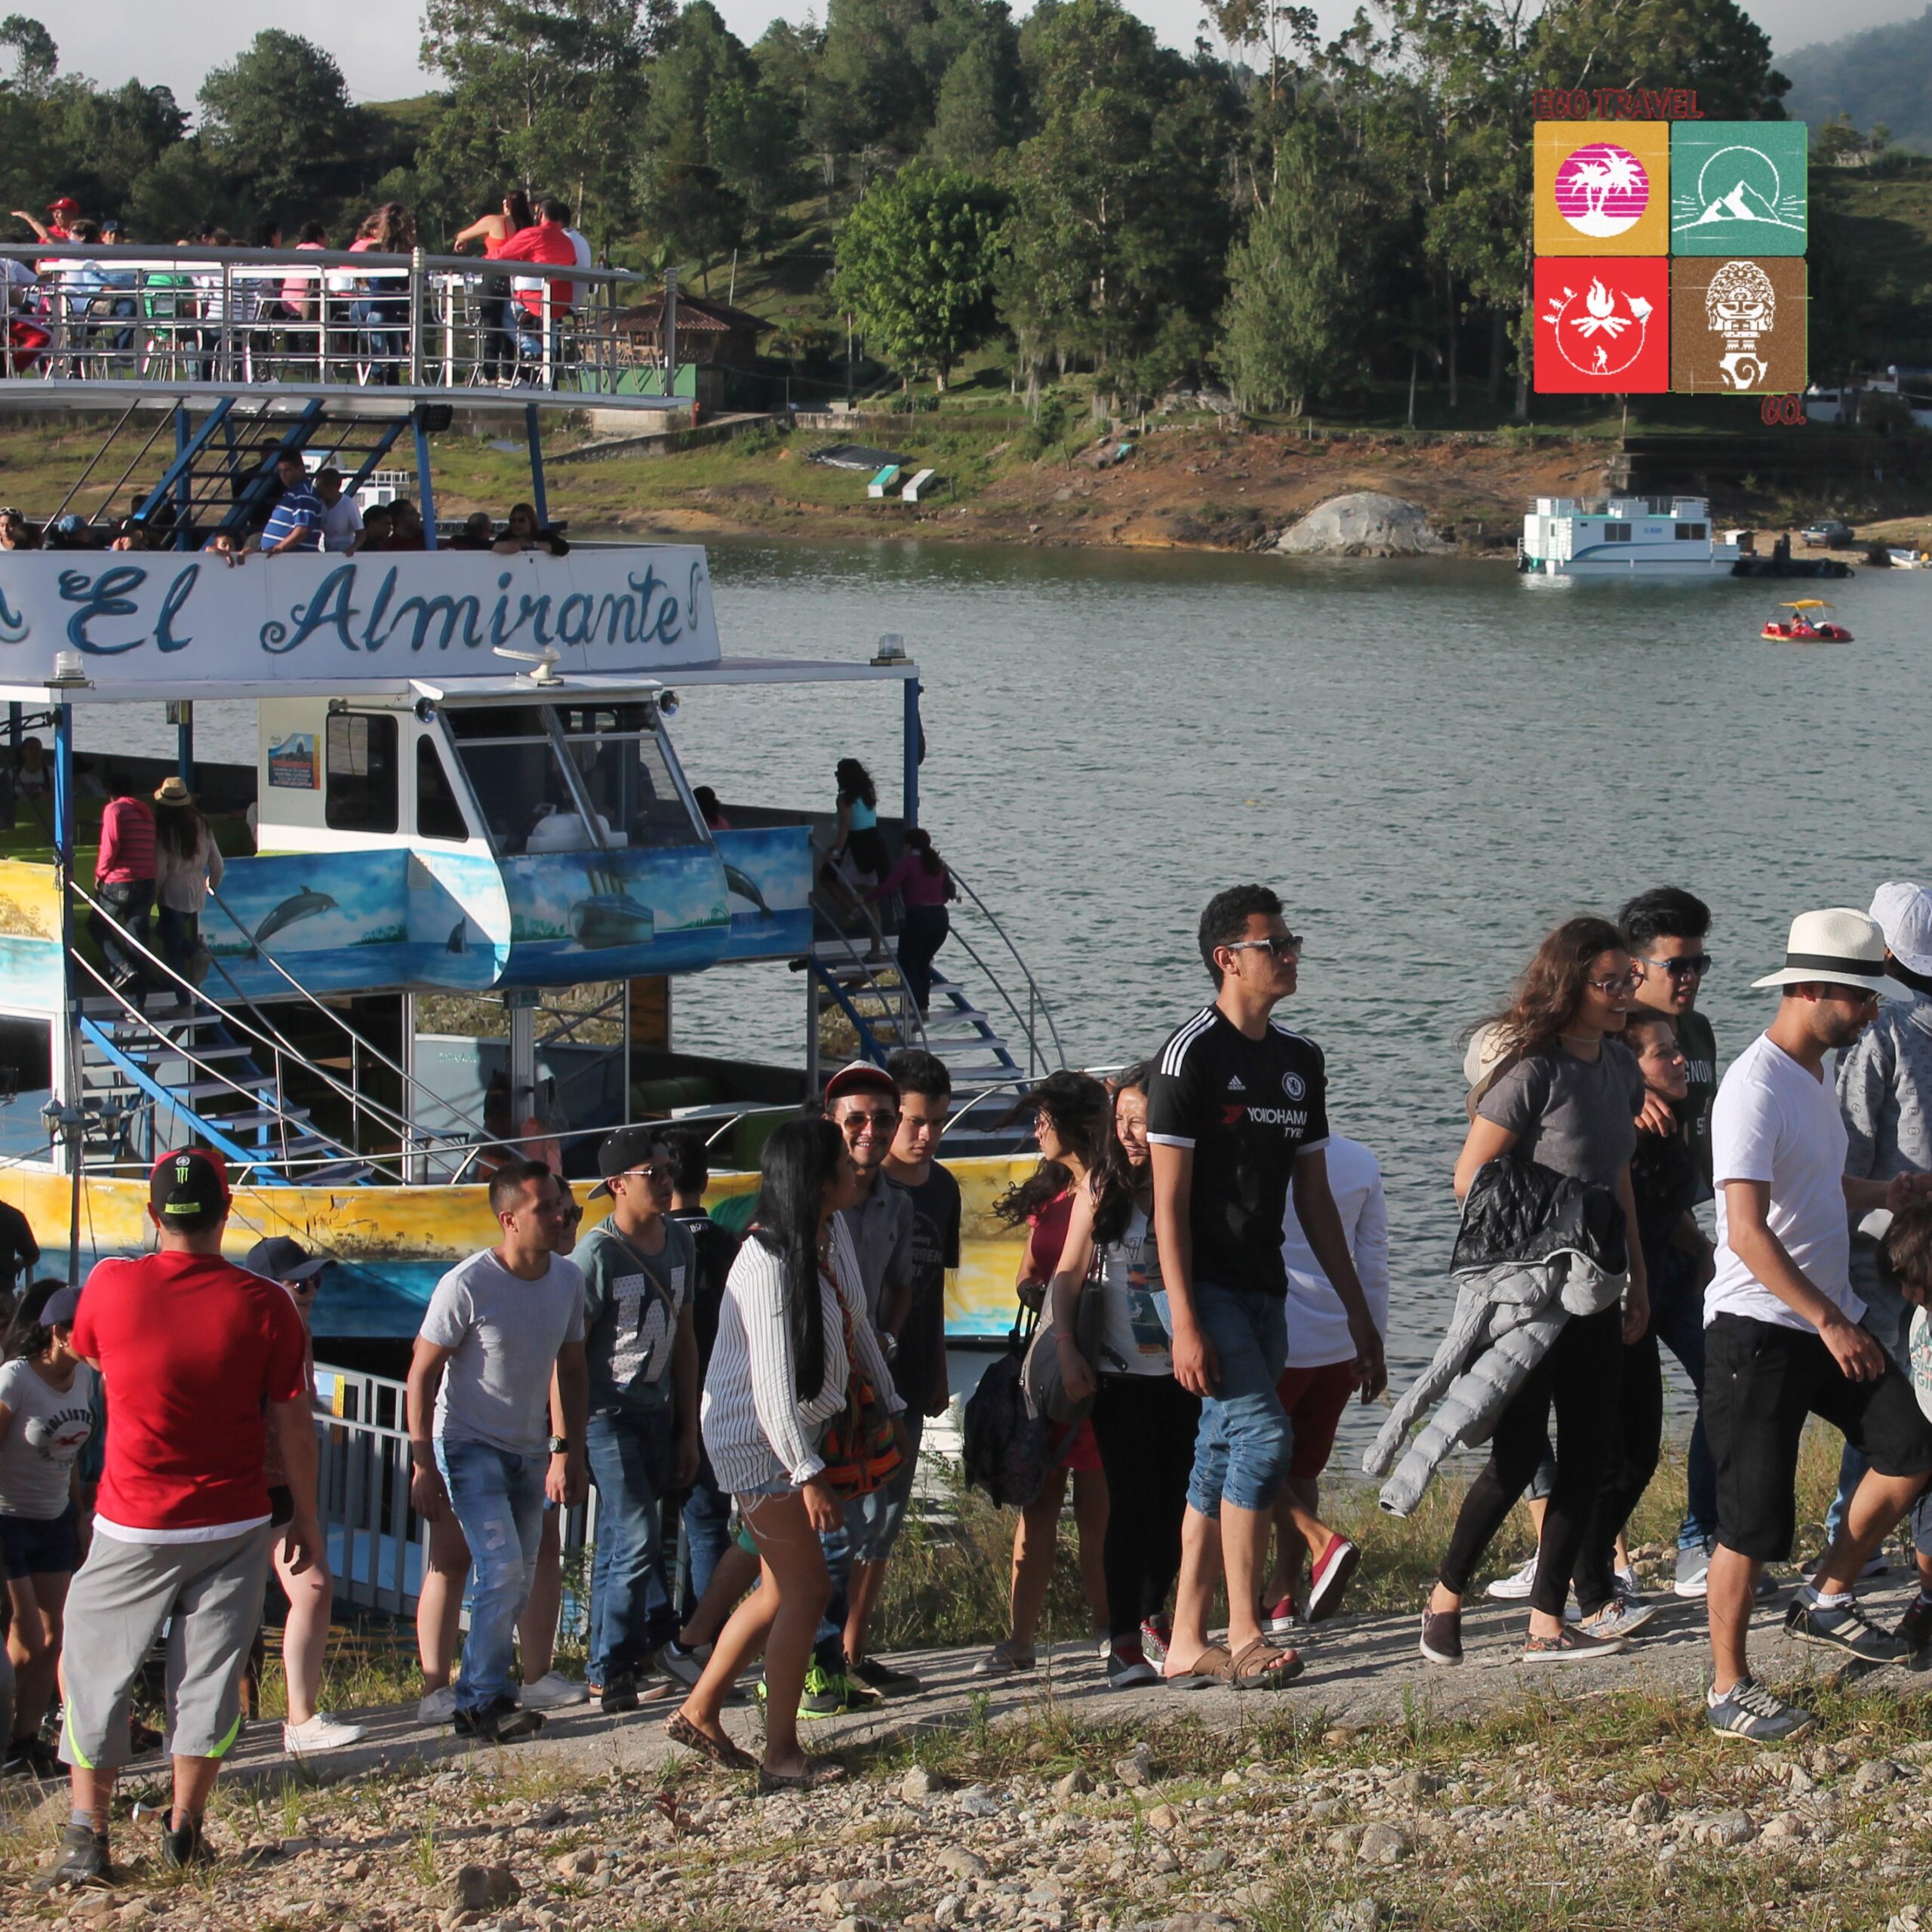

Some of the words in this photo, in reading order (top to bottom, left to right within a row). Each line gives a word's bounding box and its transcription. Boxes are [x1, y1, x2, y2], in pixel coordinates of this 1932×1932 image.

[58, 564, 201, 654] El
[260, 562, 683, 654] Almirante
[42, 1407, 92, 1438] HOLLISTE
